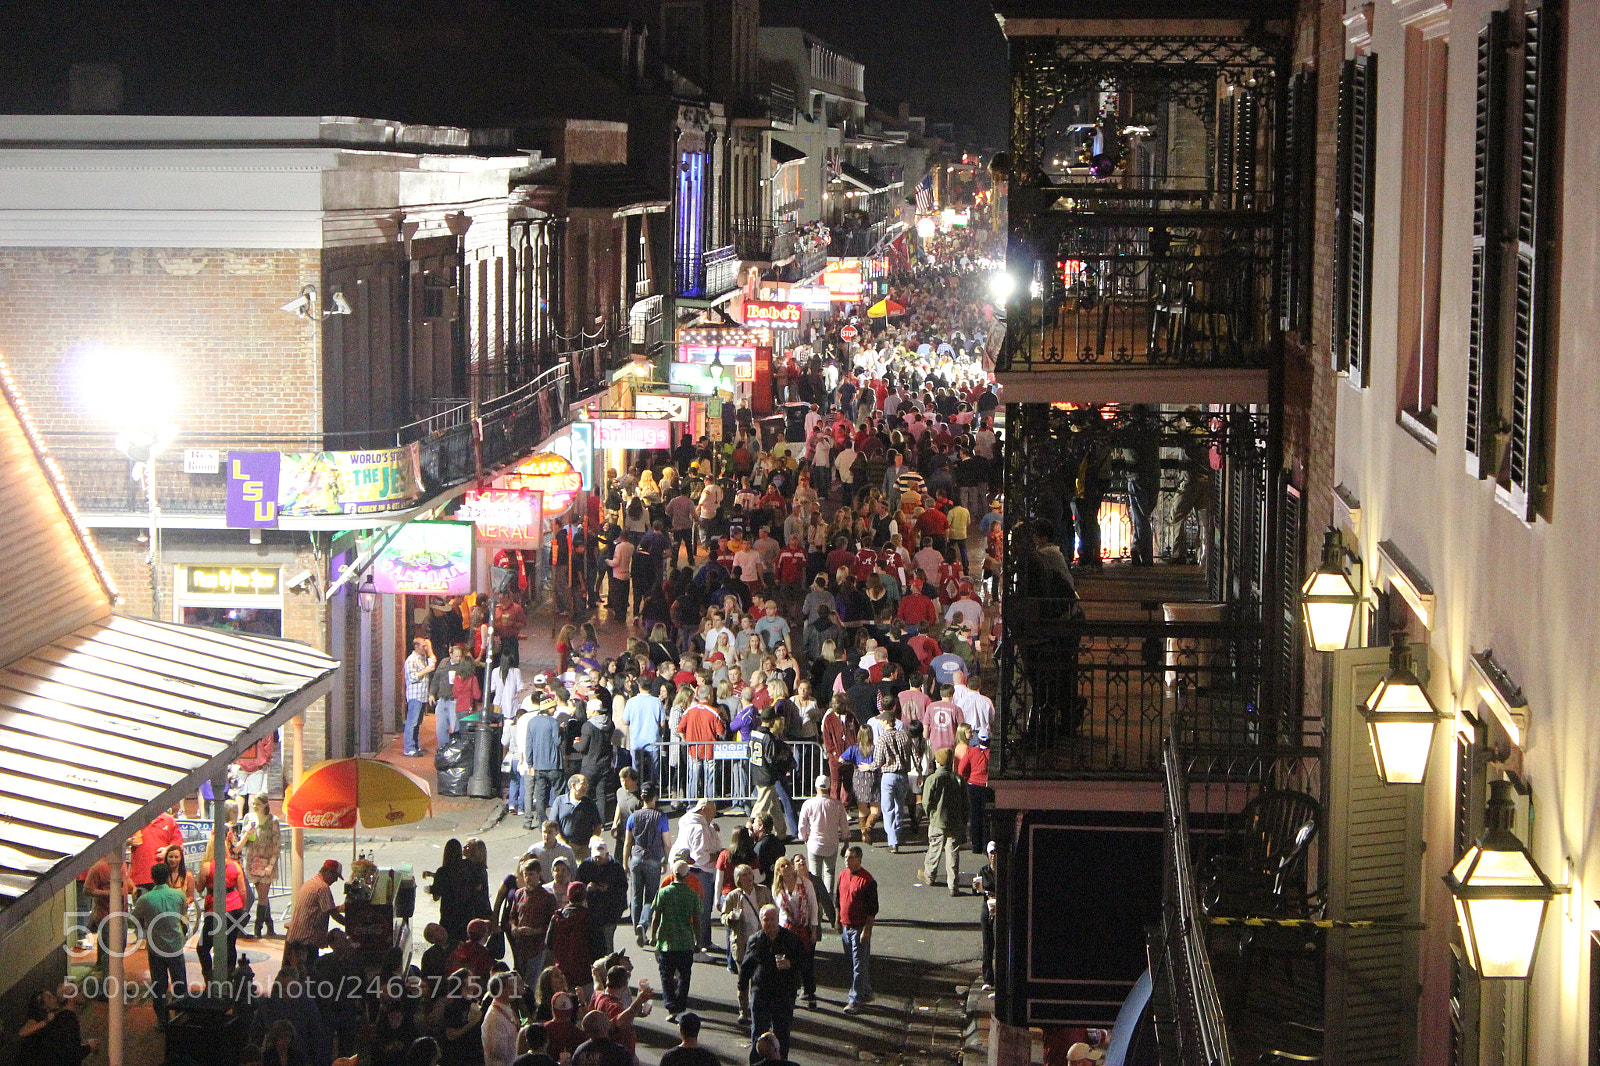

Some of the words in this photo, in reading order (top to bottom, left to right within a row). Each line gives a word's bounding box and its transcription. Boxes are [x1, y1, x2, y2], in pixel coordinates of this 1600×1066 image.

[842, 330, 857, 338] STOP
[350, 452, 388, 464] WORLD'S
[540, 460, 568, 474] EASY
[352, 467, 379, 486] THE
[379, 466, 405, 498] JE
[232, 459, 275, 521] LSU
[476, 523, 535, 540] NERAL
[420, 581, 450, 590] PIZZA
